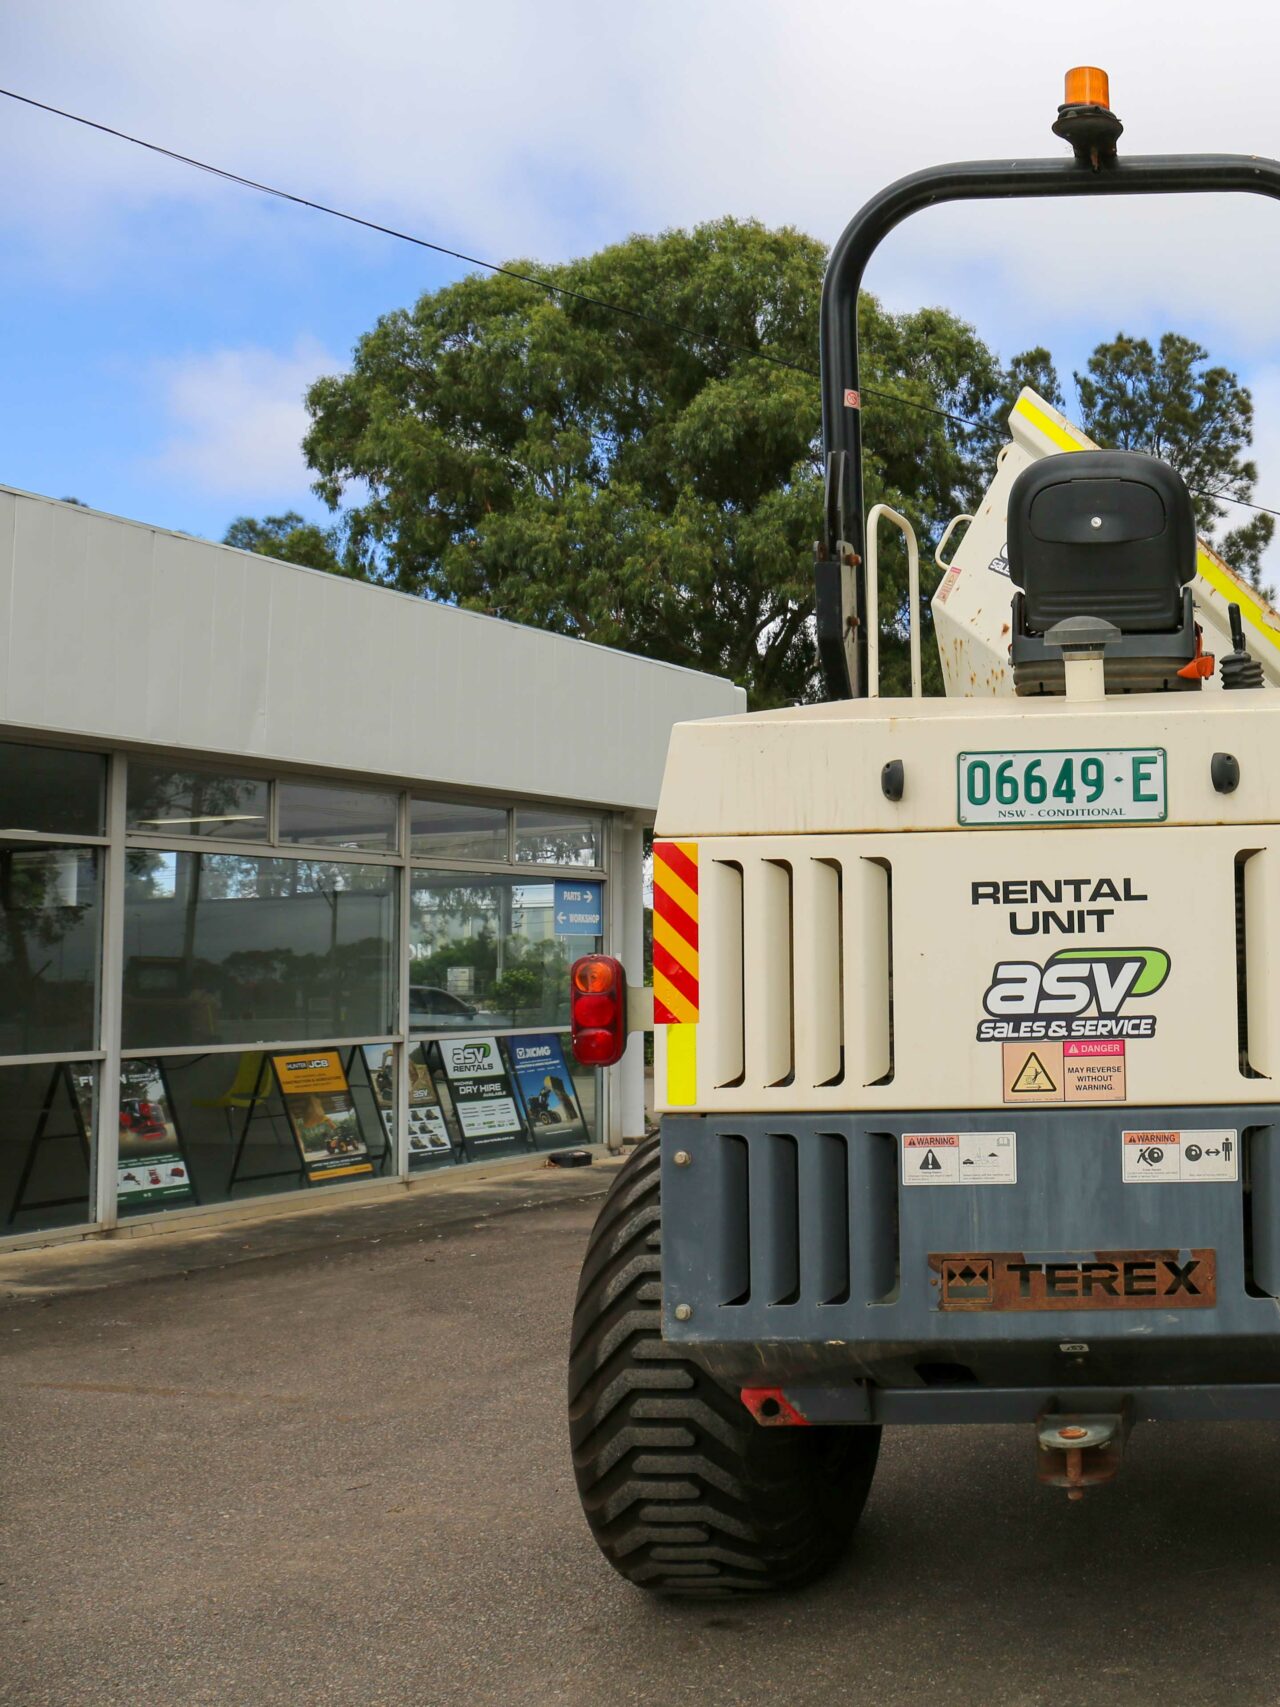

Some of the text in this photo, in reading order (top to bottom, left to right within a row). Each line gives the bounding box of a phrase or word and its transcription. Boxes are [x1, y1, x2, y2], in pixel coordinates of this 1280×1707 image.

[998, 810, 1026, 818] NSW
[1038, 808, 1126, 818] CONDITIONAL
[563, 891, 581, 901] PARTS
[971, 878, 1148, 905] RENTAL
[568, 913, 600, 924] WORKSHOP
[1009, 909, 1115, 935] UNIT
[1048, 1020, 1069, 1037] &
[1071, 1019, 1153, 1036] SERVICE
[1081, 1044, 1120, 1053] DANGER
[308, 1060, 329, 1068] JCB
[453, 1063, 494, 1073] RENTALS
[459, 1083, 501, 1095] DRY HIRE
[917, 1137, 955, 1145] WARNING
[1137, 1135, 1176, 1143] WARNING
[1006, 1261, 1201, 1298] TEREX
